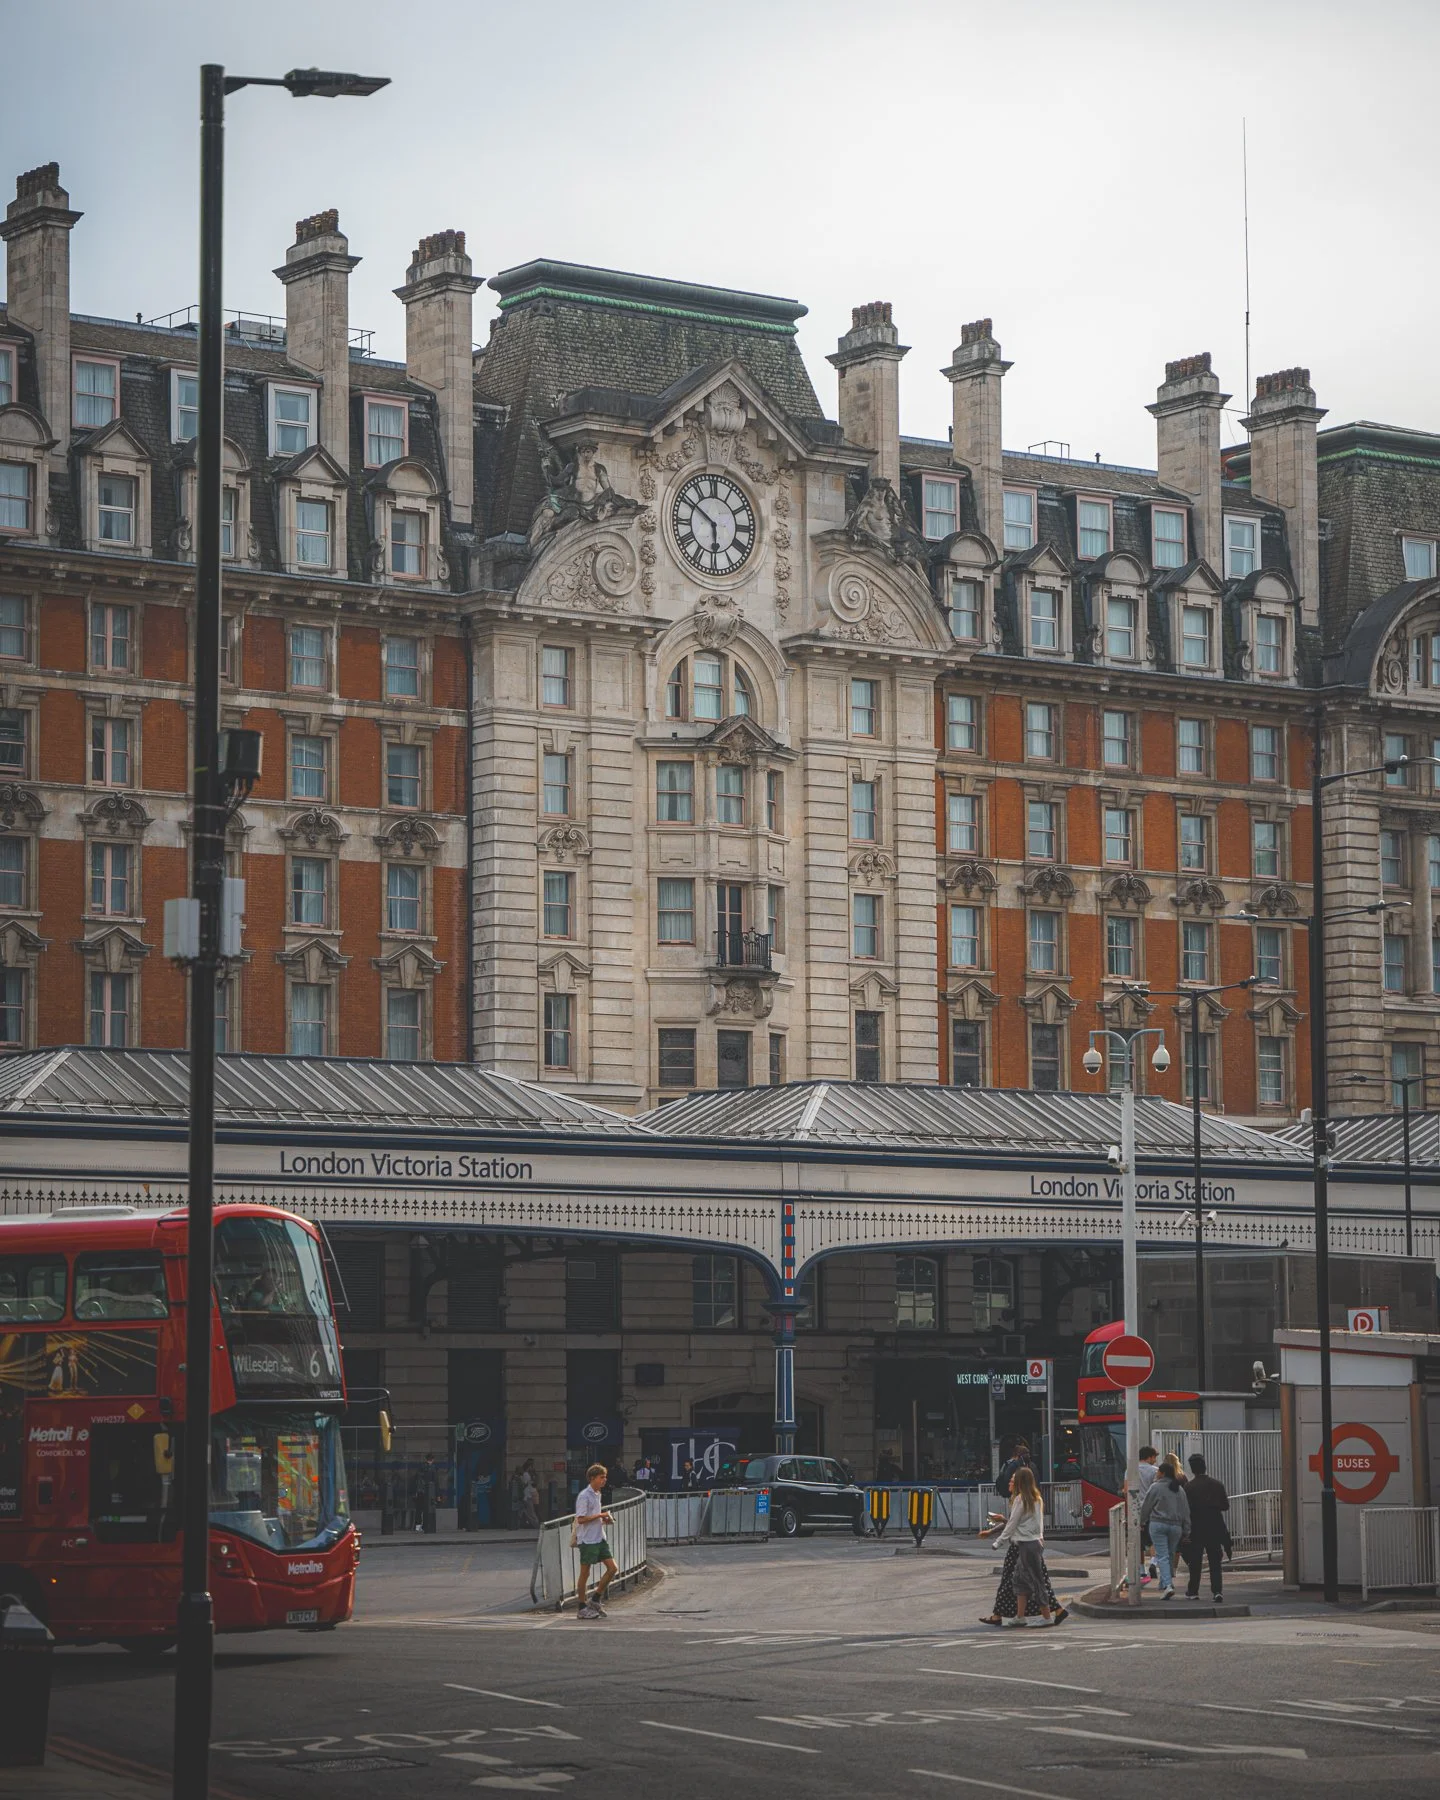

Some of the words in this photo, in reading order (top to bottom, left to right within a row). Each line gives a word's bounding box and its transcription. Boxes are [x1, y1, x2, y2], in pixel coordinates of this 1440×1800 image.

[280, 1151, 365, 1175] London
[371, 1153, 452, 1177] Victoria
[458, 1155, 532, 1179] Station
[1031, 1175, 1098, 1197] London
[1103, 1178, 1170, 1200] Vioria
[1356, 1316, 1370, 1332] D
[232, 1355, 278, 1373] Willesden
[310, 1350, 320, 1378] 6
[1032, 1365, 1040, 1374] A
[957, 1374, 971, 1385] WEST
[1003, 1374, 1020, 1385] PASTY
[1092, 1397, 1116, 1407] Crystal
[90, 1415, 125, 1424] VWH2373
[1337, 1458, 1370, 1468] BUSES
[288, 1560, 324, 1575] Metroline
